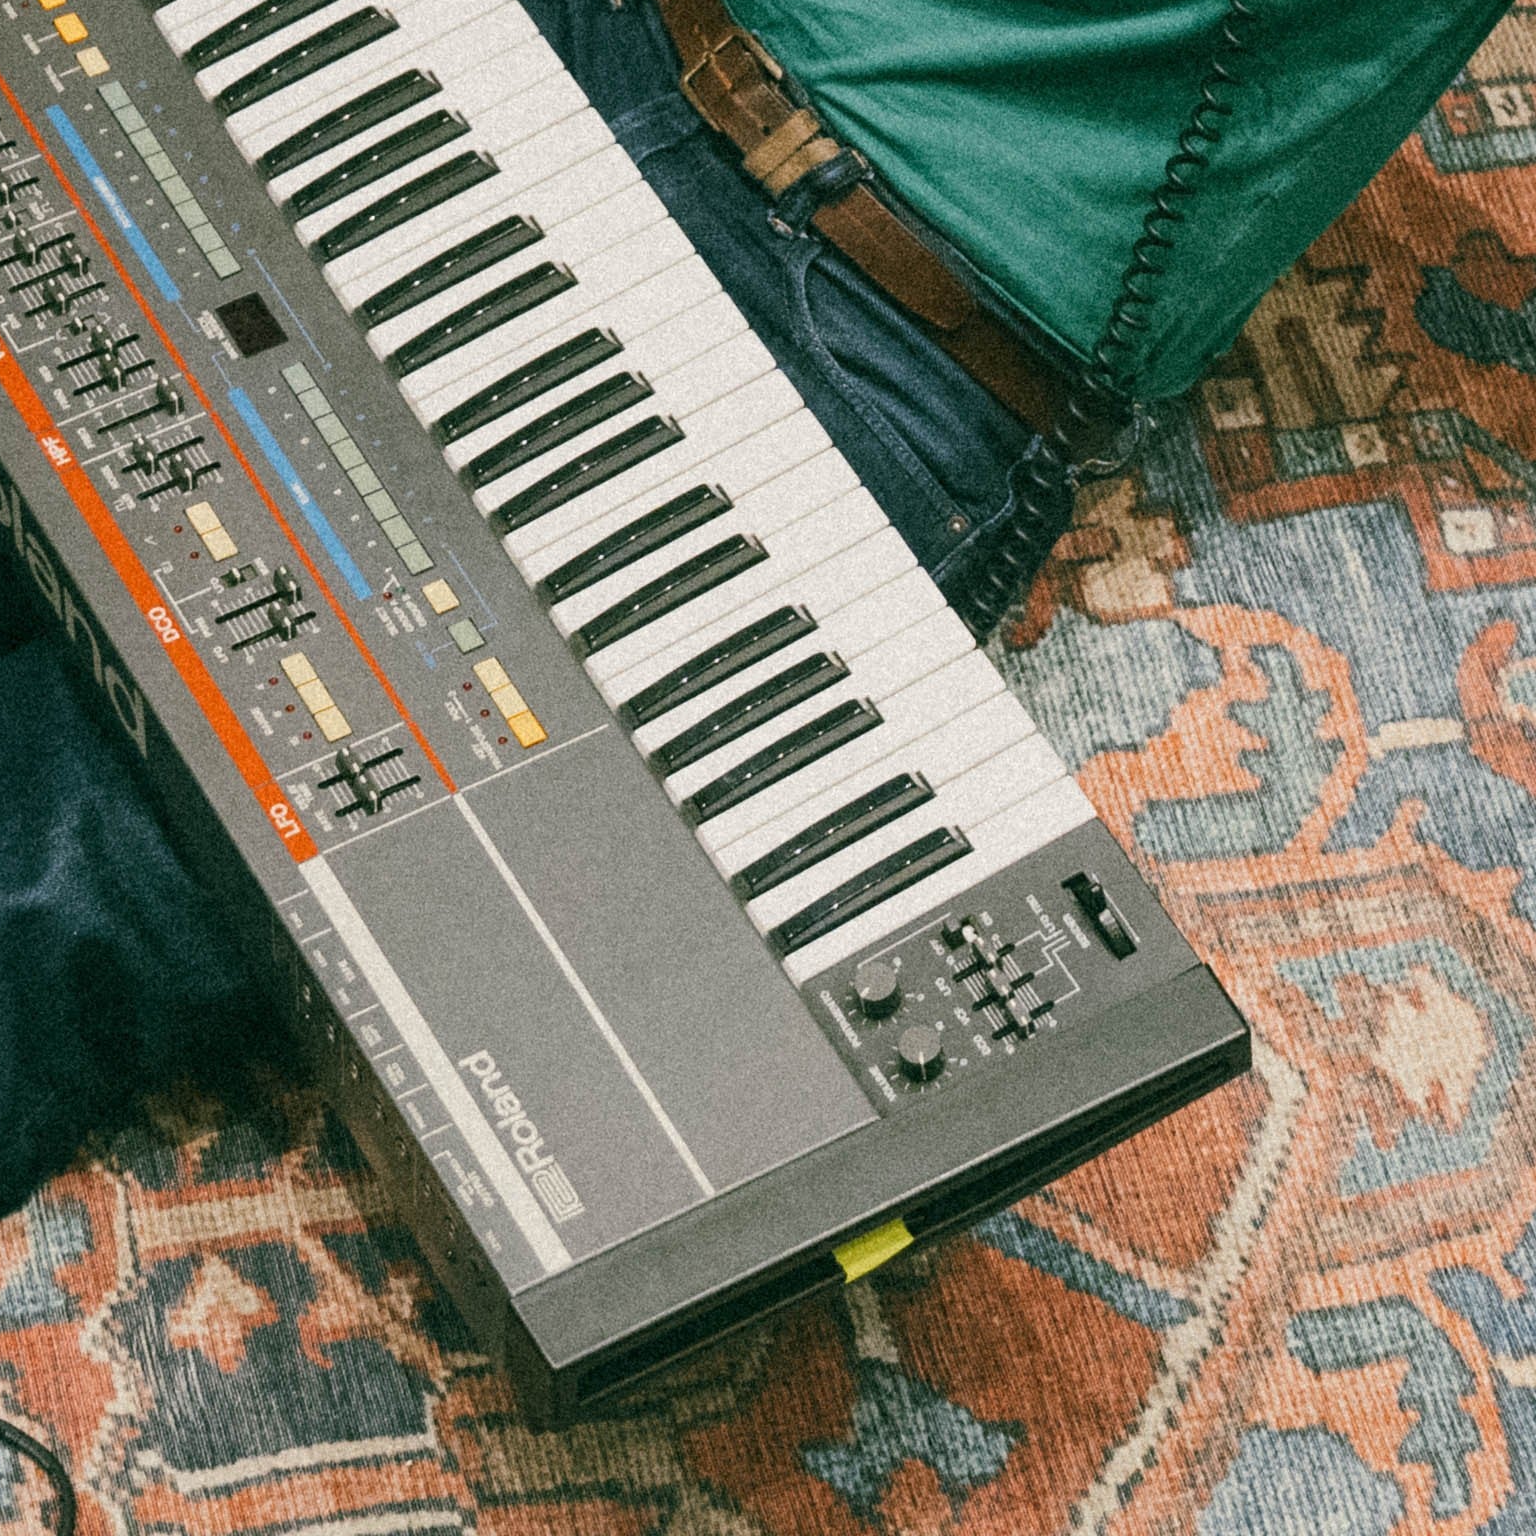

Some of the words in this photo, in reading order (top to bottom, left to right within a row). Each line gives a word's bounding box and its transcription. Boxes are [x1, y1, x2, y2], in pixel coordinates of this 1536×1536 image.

[41, 437, 71, 466] HPF
[147, 606, 180, 643] DCO
[270, 803, 301, 838] LFO
[458, 1049, 554, 1175] Roland
